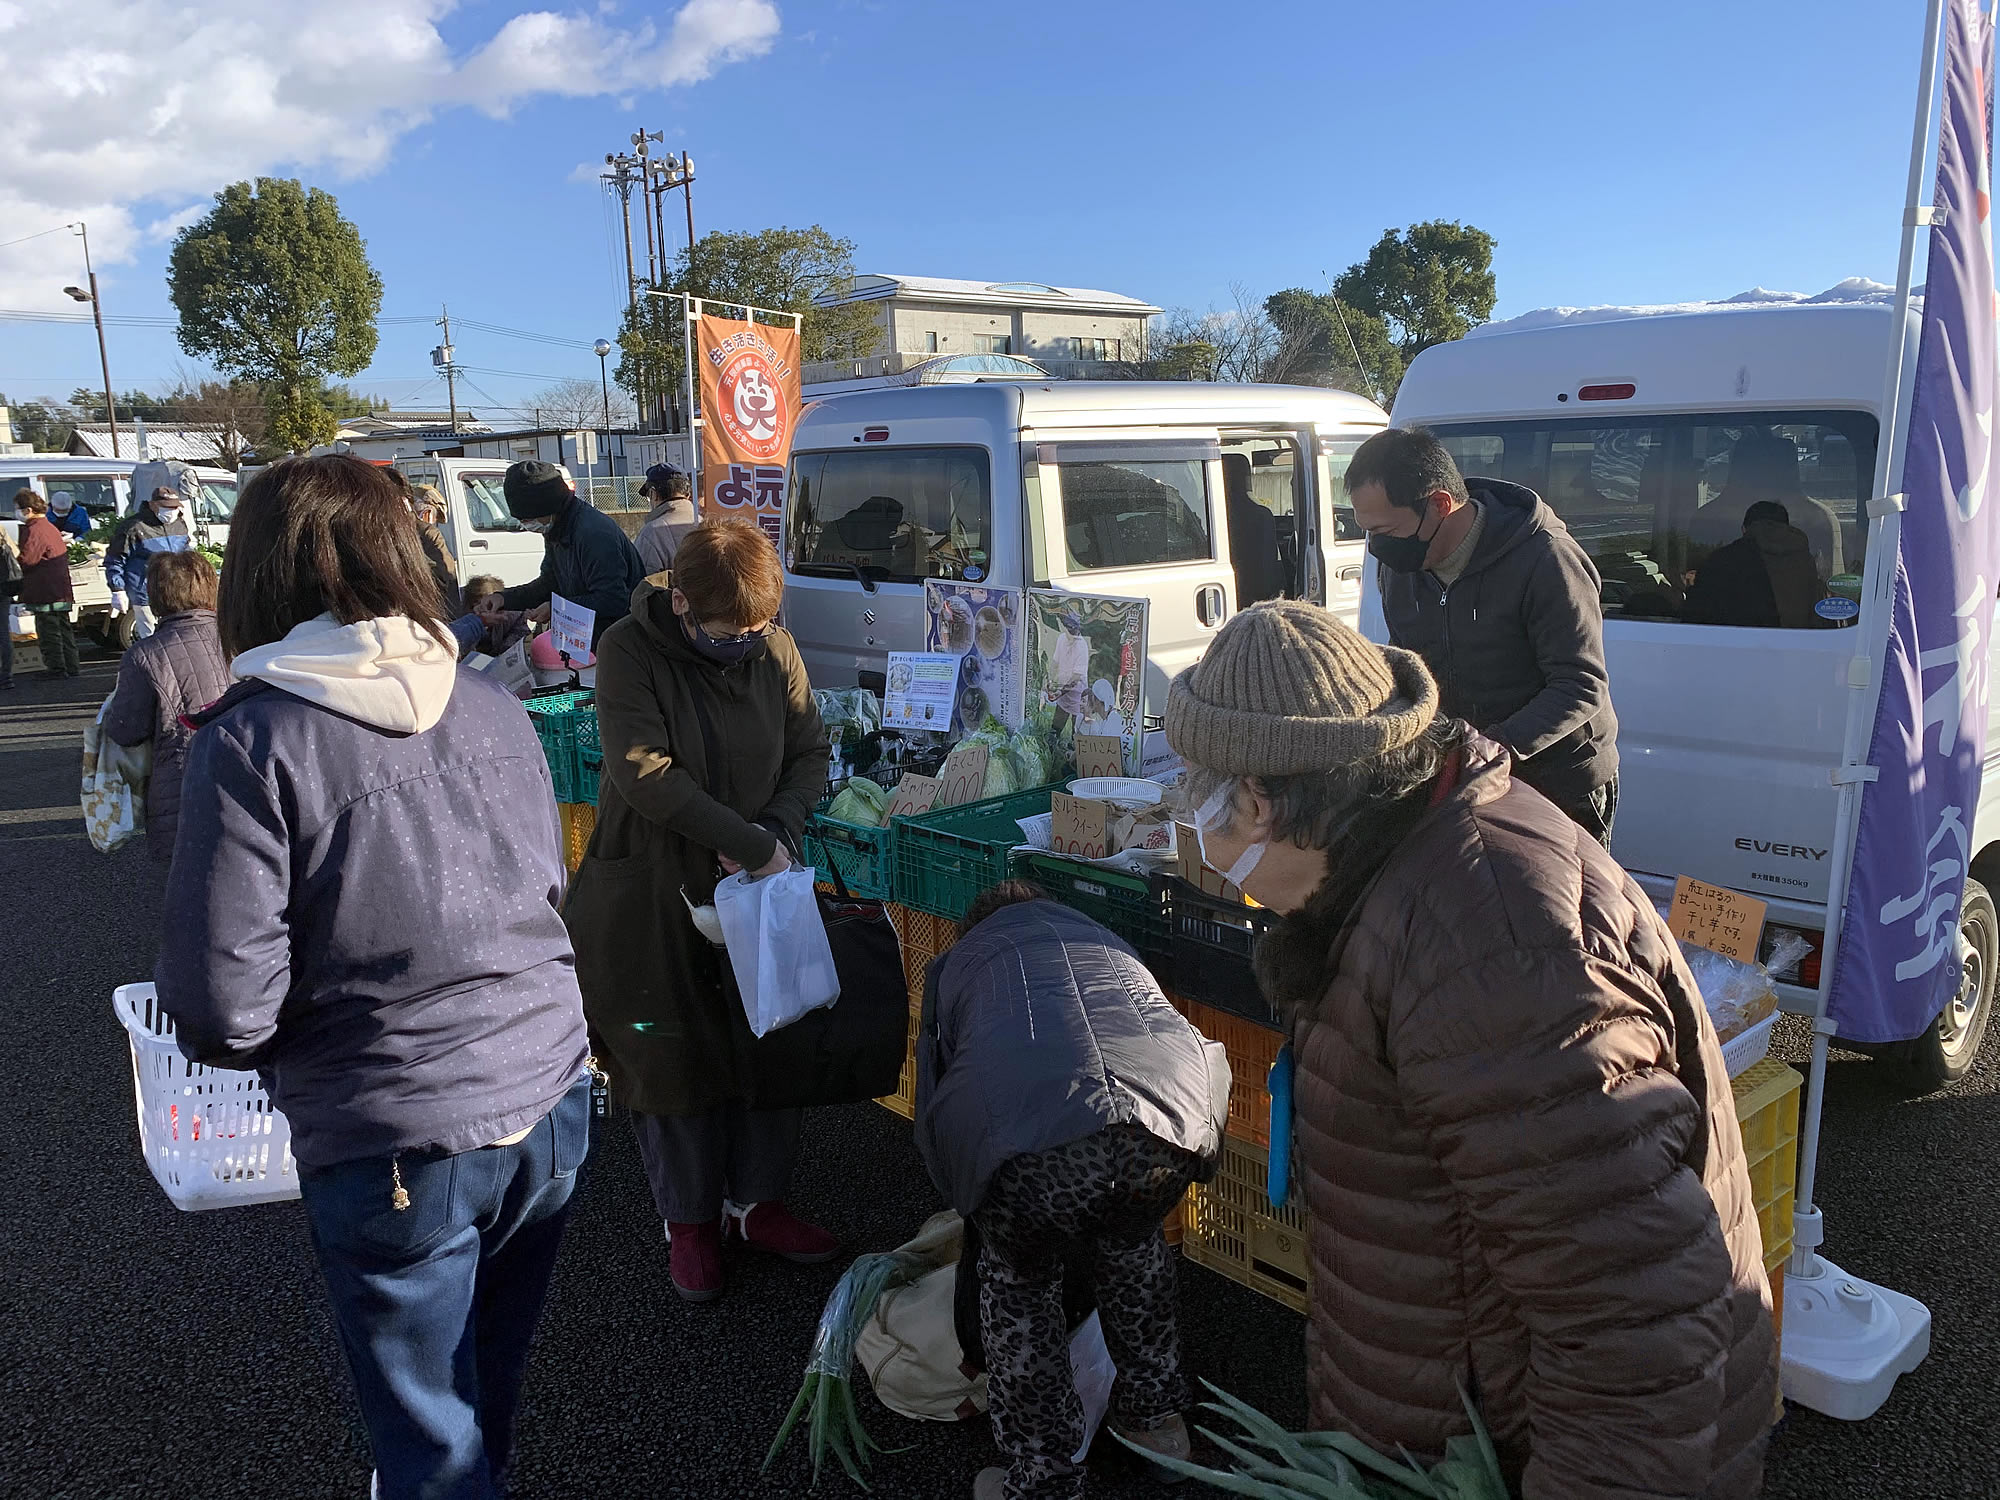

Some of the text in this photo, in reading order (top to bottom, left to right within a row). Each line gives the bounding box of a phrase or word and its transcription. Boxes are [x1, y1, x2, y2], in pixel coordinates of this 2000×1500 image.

[1077, 739, 1117, 756] だいこん
[947, 749, 986, 773] はくさい
[1053, 796, 1088, 815] ミルキー
[1072, 817, 1104, 838] クイーン
[1734, 838, 1828, 861] EVERY
[1687, 880, 1736, 903] 紅はるか
